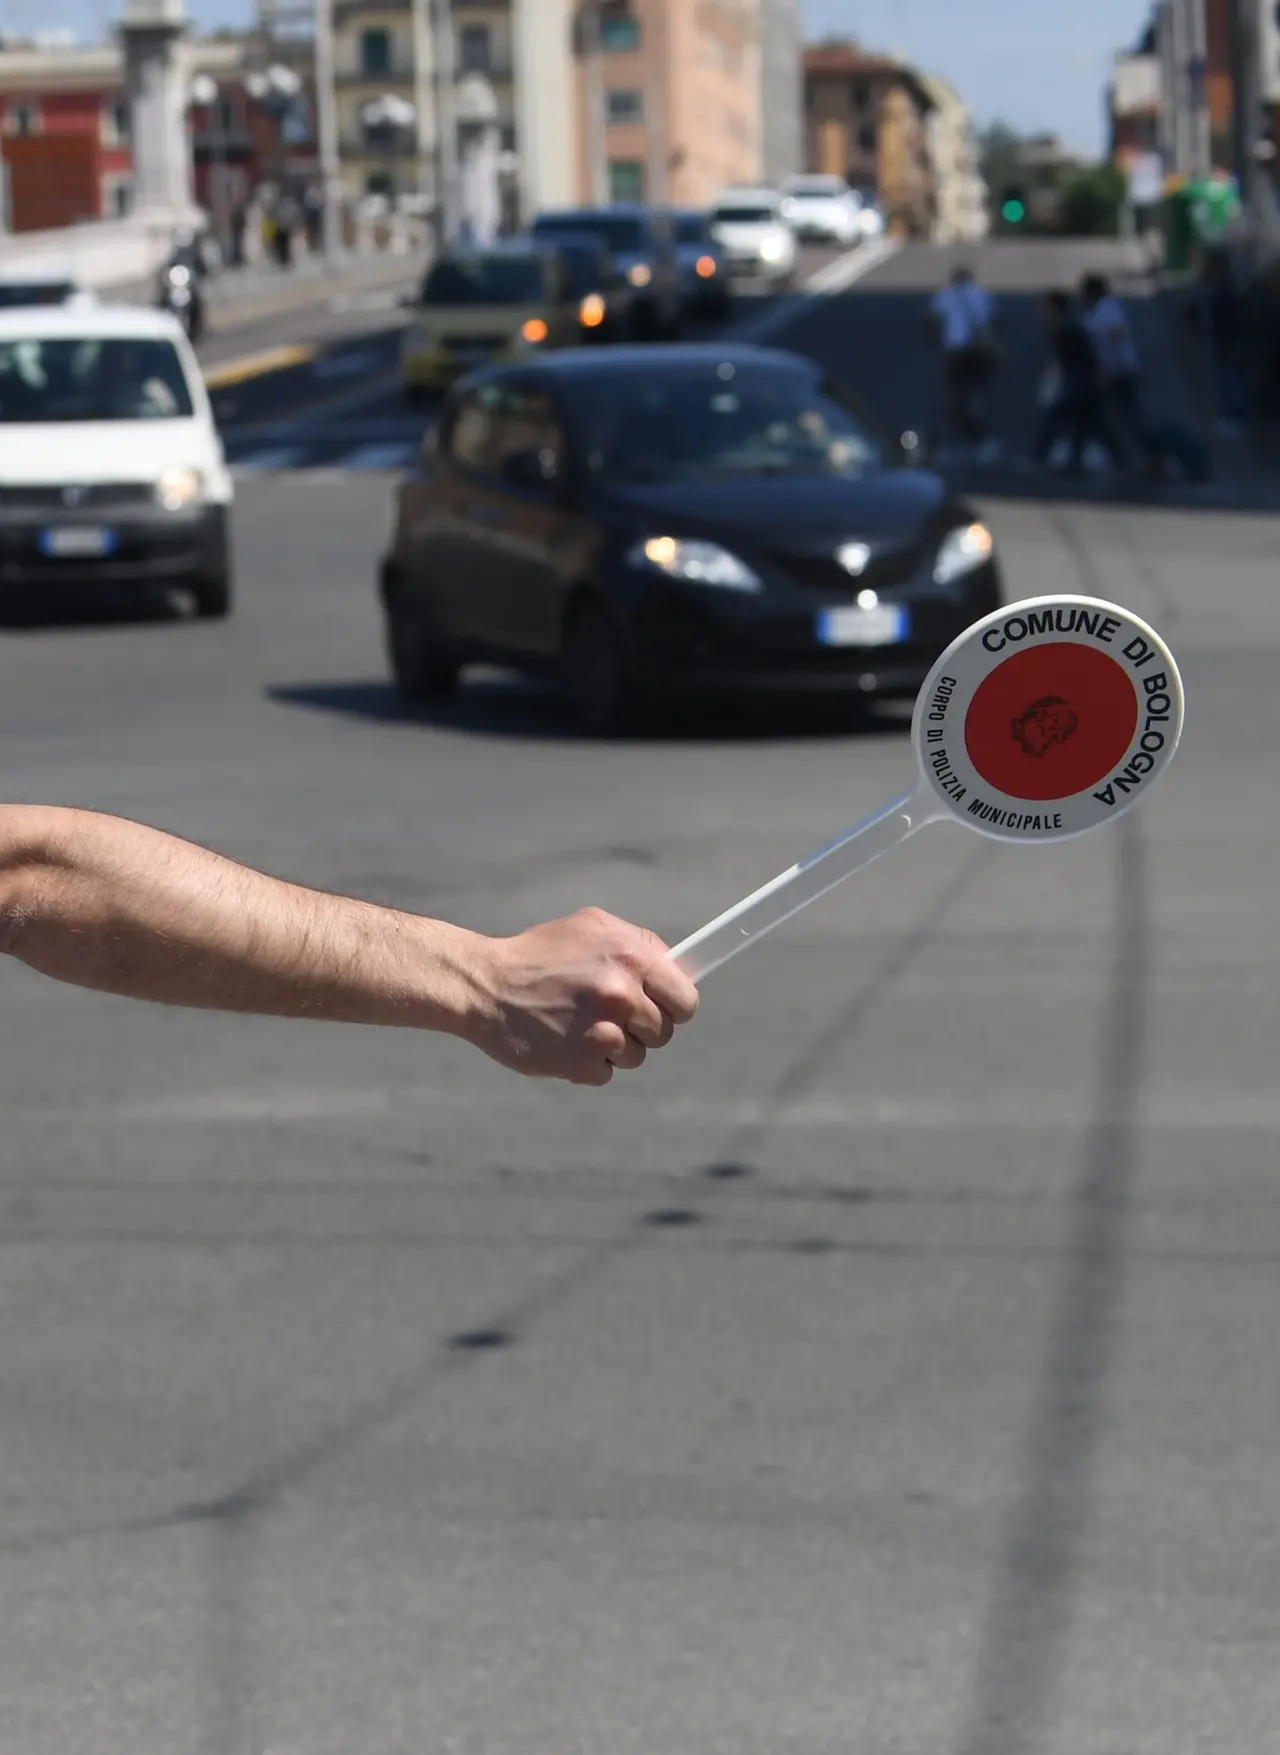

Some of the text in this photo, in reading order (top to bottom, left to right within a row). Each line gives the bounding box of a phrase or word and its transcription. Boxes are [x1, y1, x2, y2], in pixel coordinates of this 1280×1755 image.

[927, 676, 1062, 830] CORPO DI POLIZIA MUNICIPALE
[982, 609, 1171, 806] COMUNE DI BOLOGNA
